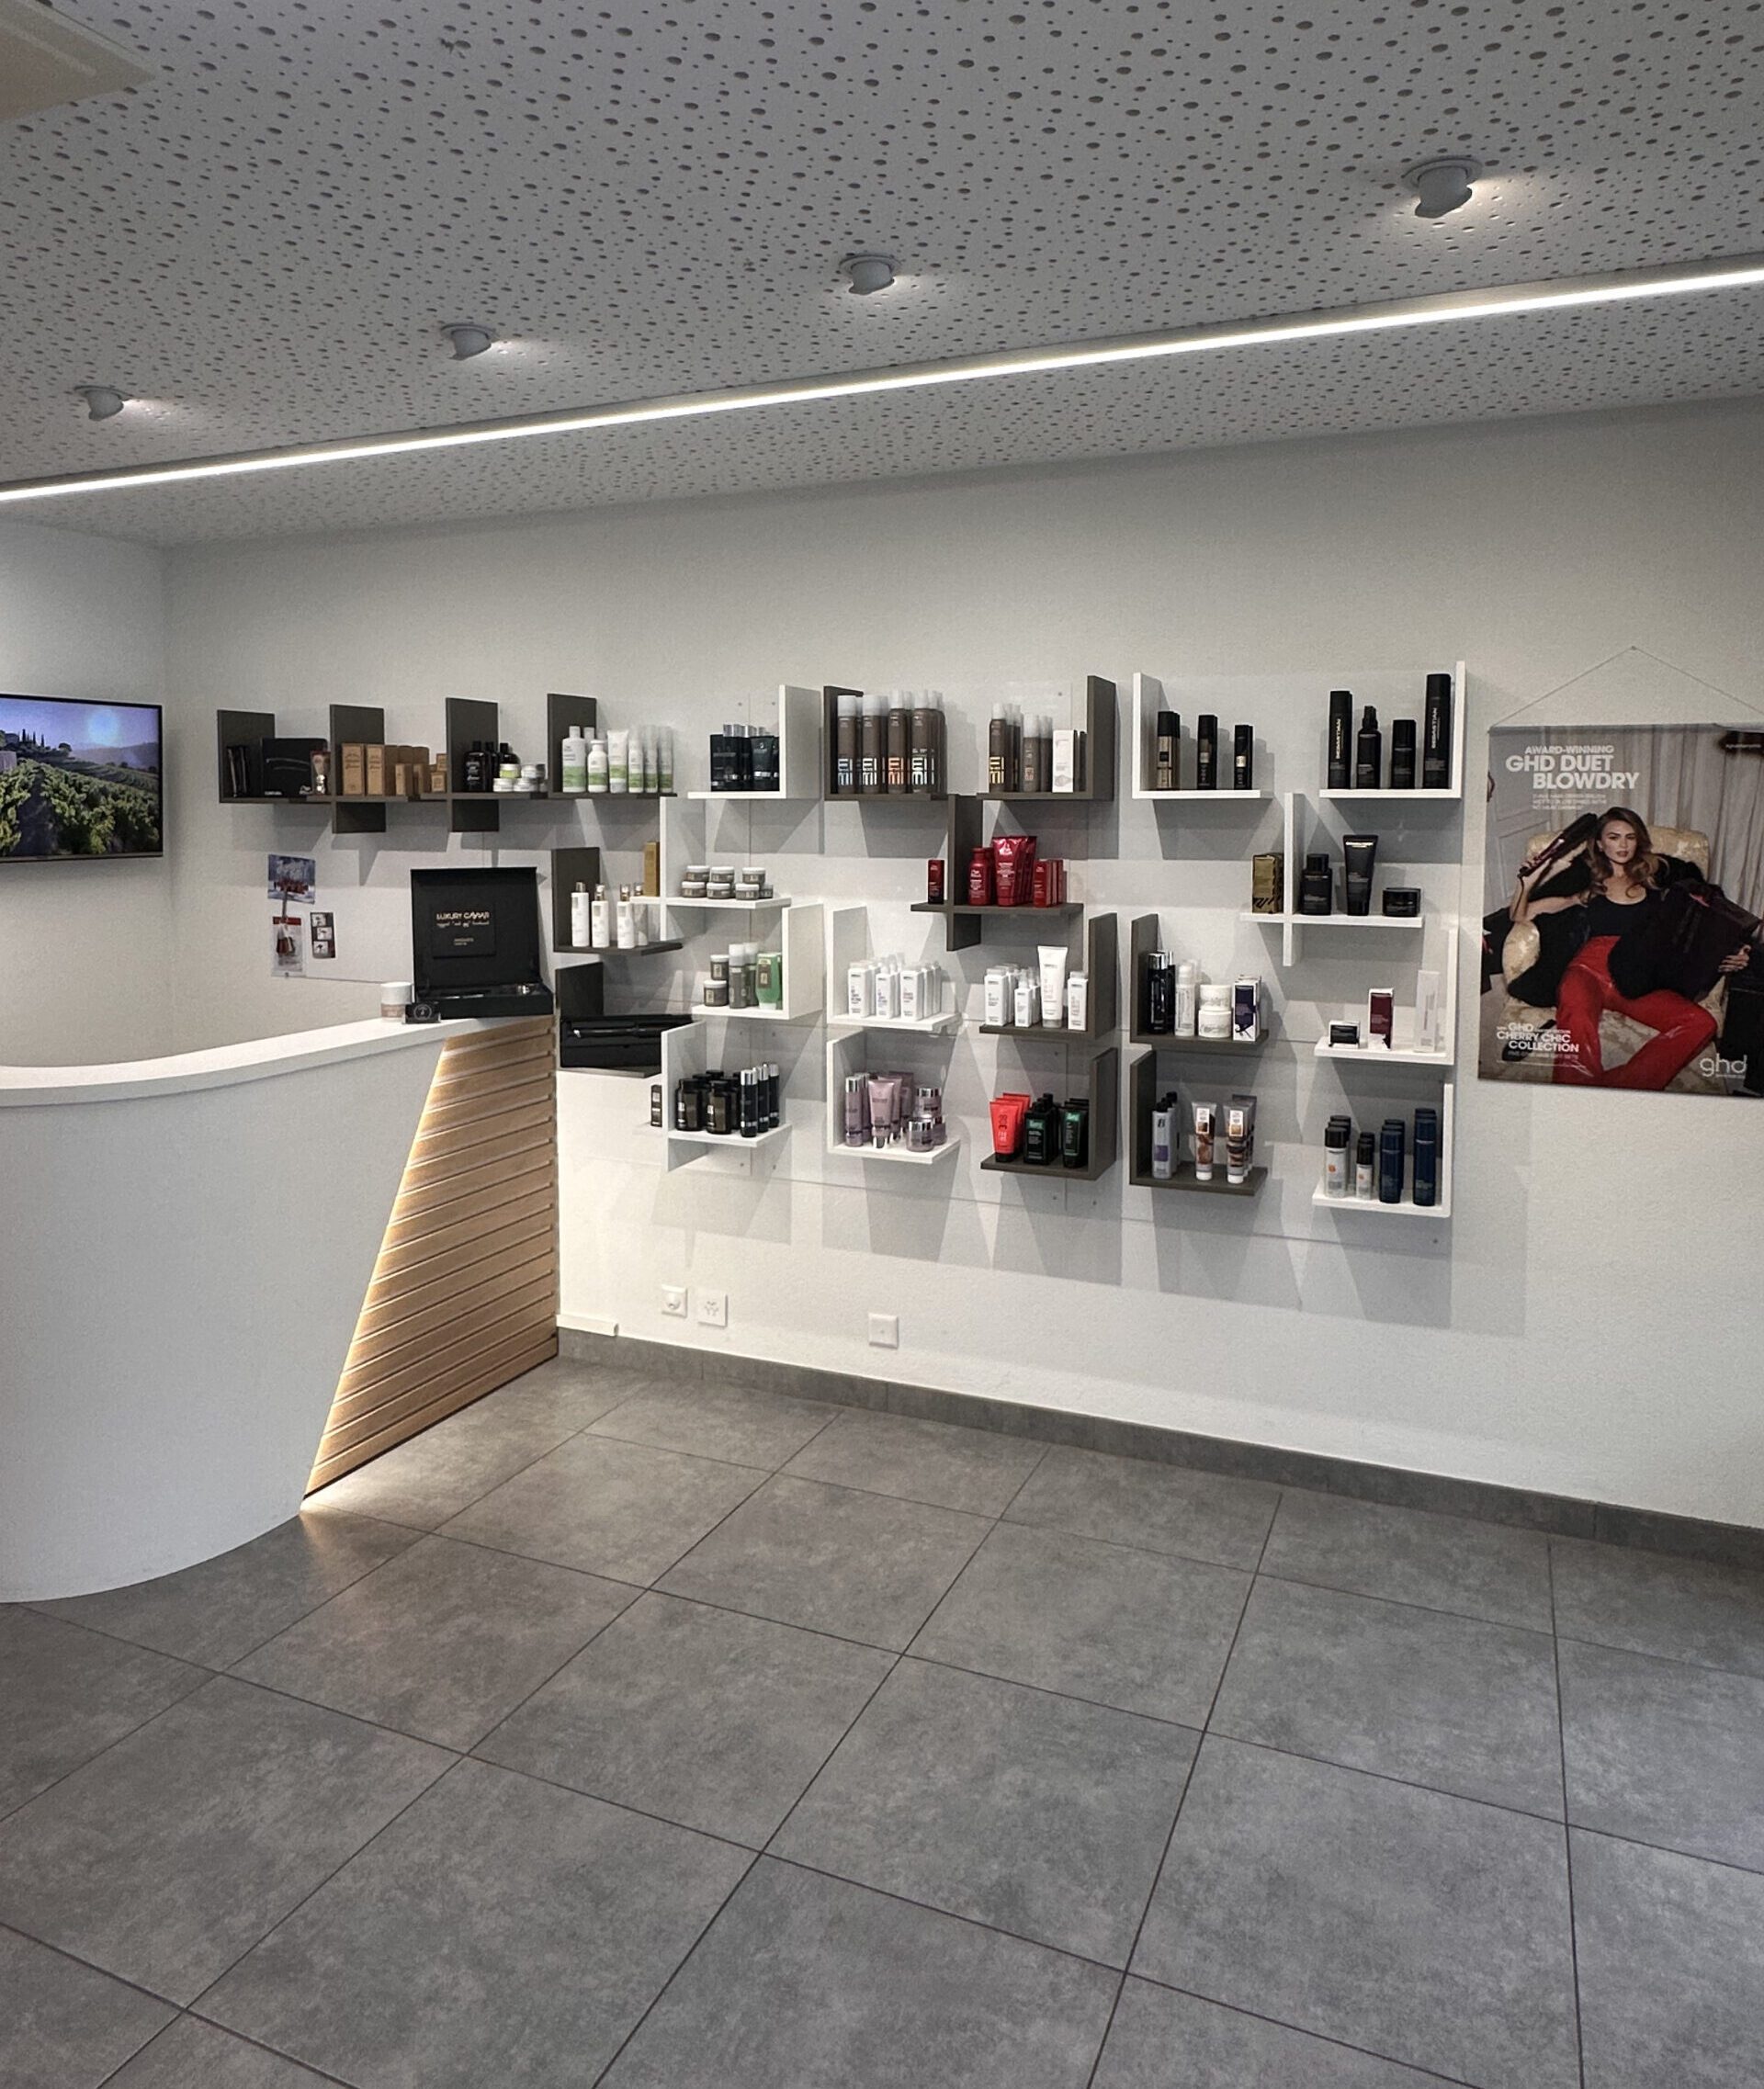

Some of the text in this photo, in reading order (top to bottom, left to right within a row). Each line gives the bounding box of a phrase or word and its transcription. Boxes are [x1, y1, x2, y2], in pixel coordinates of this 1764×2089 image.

[1524, 745, 1615, 755] AWARD-WINNING
[1505, 754, 1615, 773] GHD DUET
[1532, 772, 1641, 790] BLOWDRY
[1508, 1022, 1534, 1033] GHD
[1496, 1031, 1540, 1042] CHERRY
[1541, 1033, 1571, 1044] CHIC
[1508, 1040, 1580, 1053] COLLECTION
[1700, 1053, 1747, 1078] ghd
